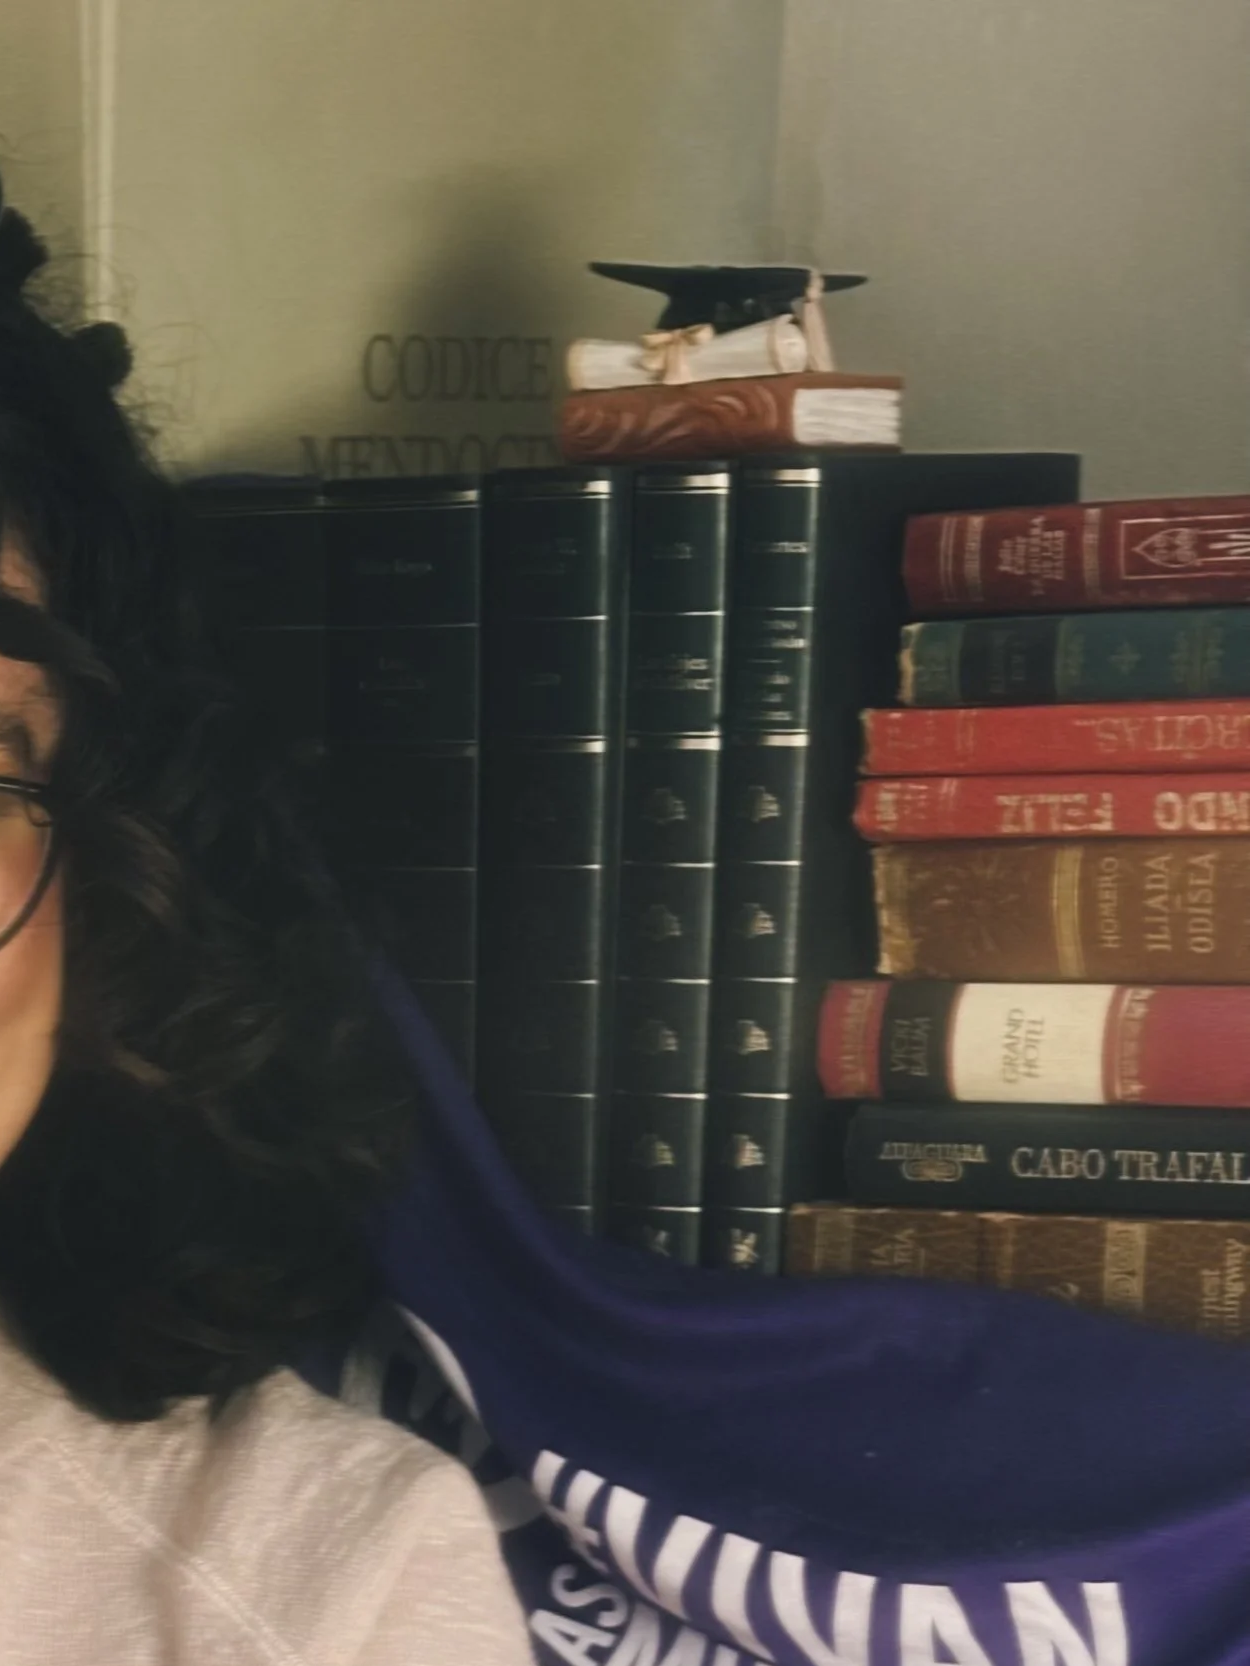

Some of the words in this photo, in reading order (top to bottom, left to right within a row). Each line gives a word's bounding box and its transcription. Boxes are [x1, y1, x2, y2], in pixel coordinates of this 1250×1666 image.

[363, 334, 550, 403] CODICE
[995, 792, 1114, 834] FELIZ
[1098, 855, 1119, 950] HOMERO
[1144, 852, 1173, 953] ILIADA
[909, 1015, 932, 1076] BAUM
[1000, 1007, 1023, 1085] GRAND
[1022, 1015, 1045, 1079] HOTEL
[1011, 1146, 1106, 1179] CABO
